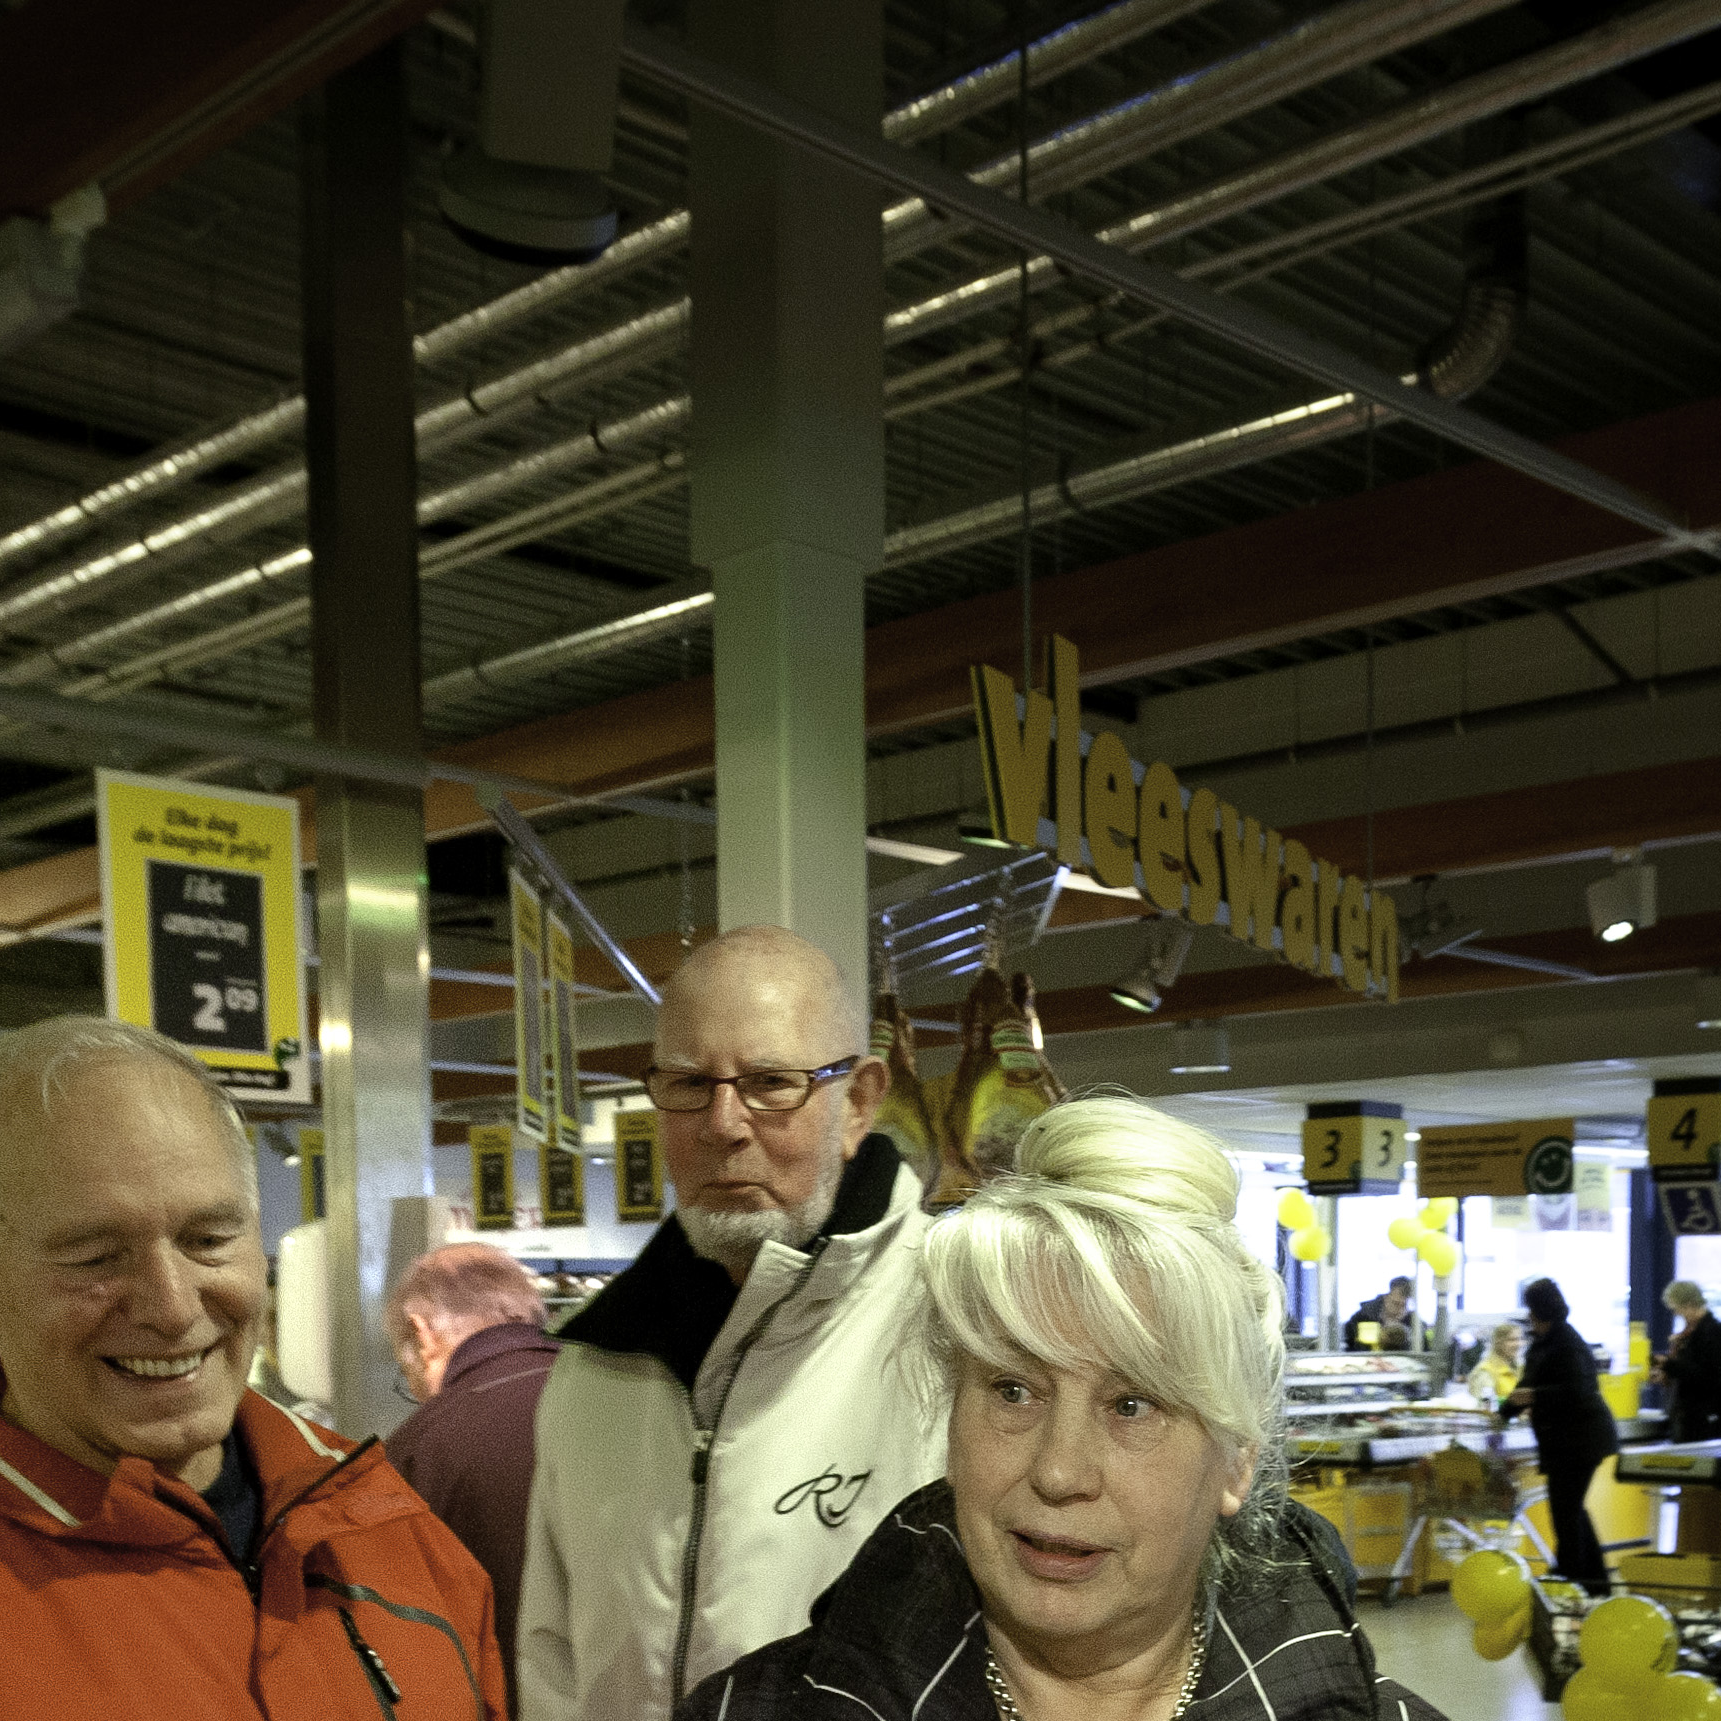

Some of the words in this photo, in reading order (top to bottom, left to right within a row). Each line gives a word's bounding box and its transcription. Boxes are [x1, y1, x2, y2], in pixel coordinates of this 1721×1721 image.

[165, 806, 201, 829] Elke
[205, 813, 240, 838] dag
[971, 633, 1400, 1005] vleeswaren
[132, 825, 156, 844] de
[158, 829, 225, 857] laagste
[191, 982, 227, 1033] 2
[1378, 1129, 1394, 1168] 3
[1670, 1107, 1699, 1150] 4
[1320, 1129, 1342, 1169] 3
